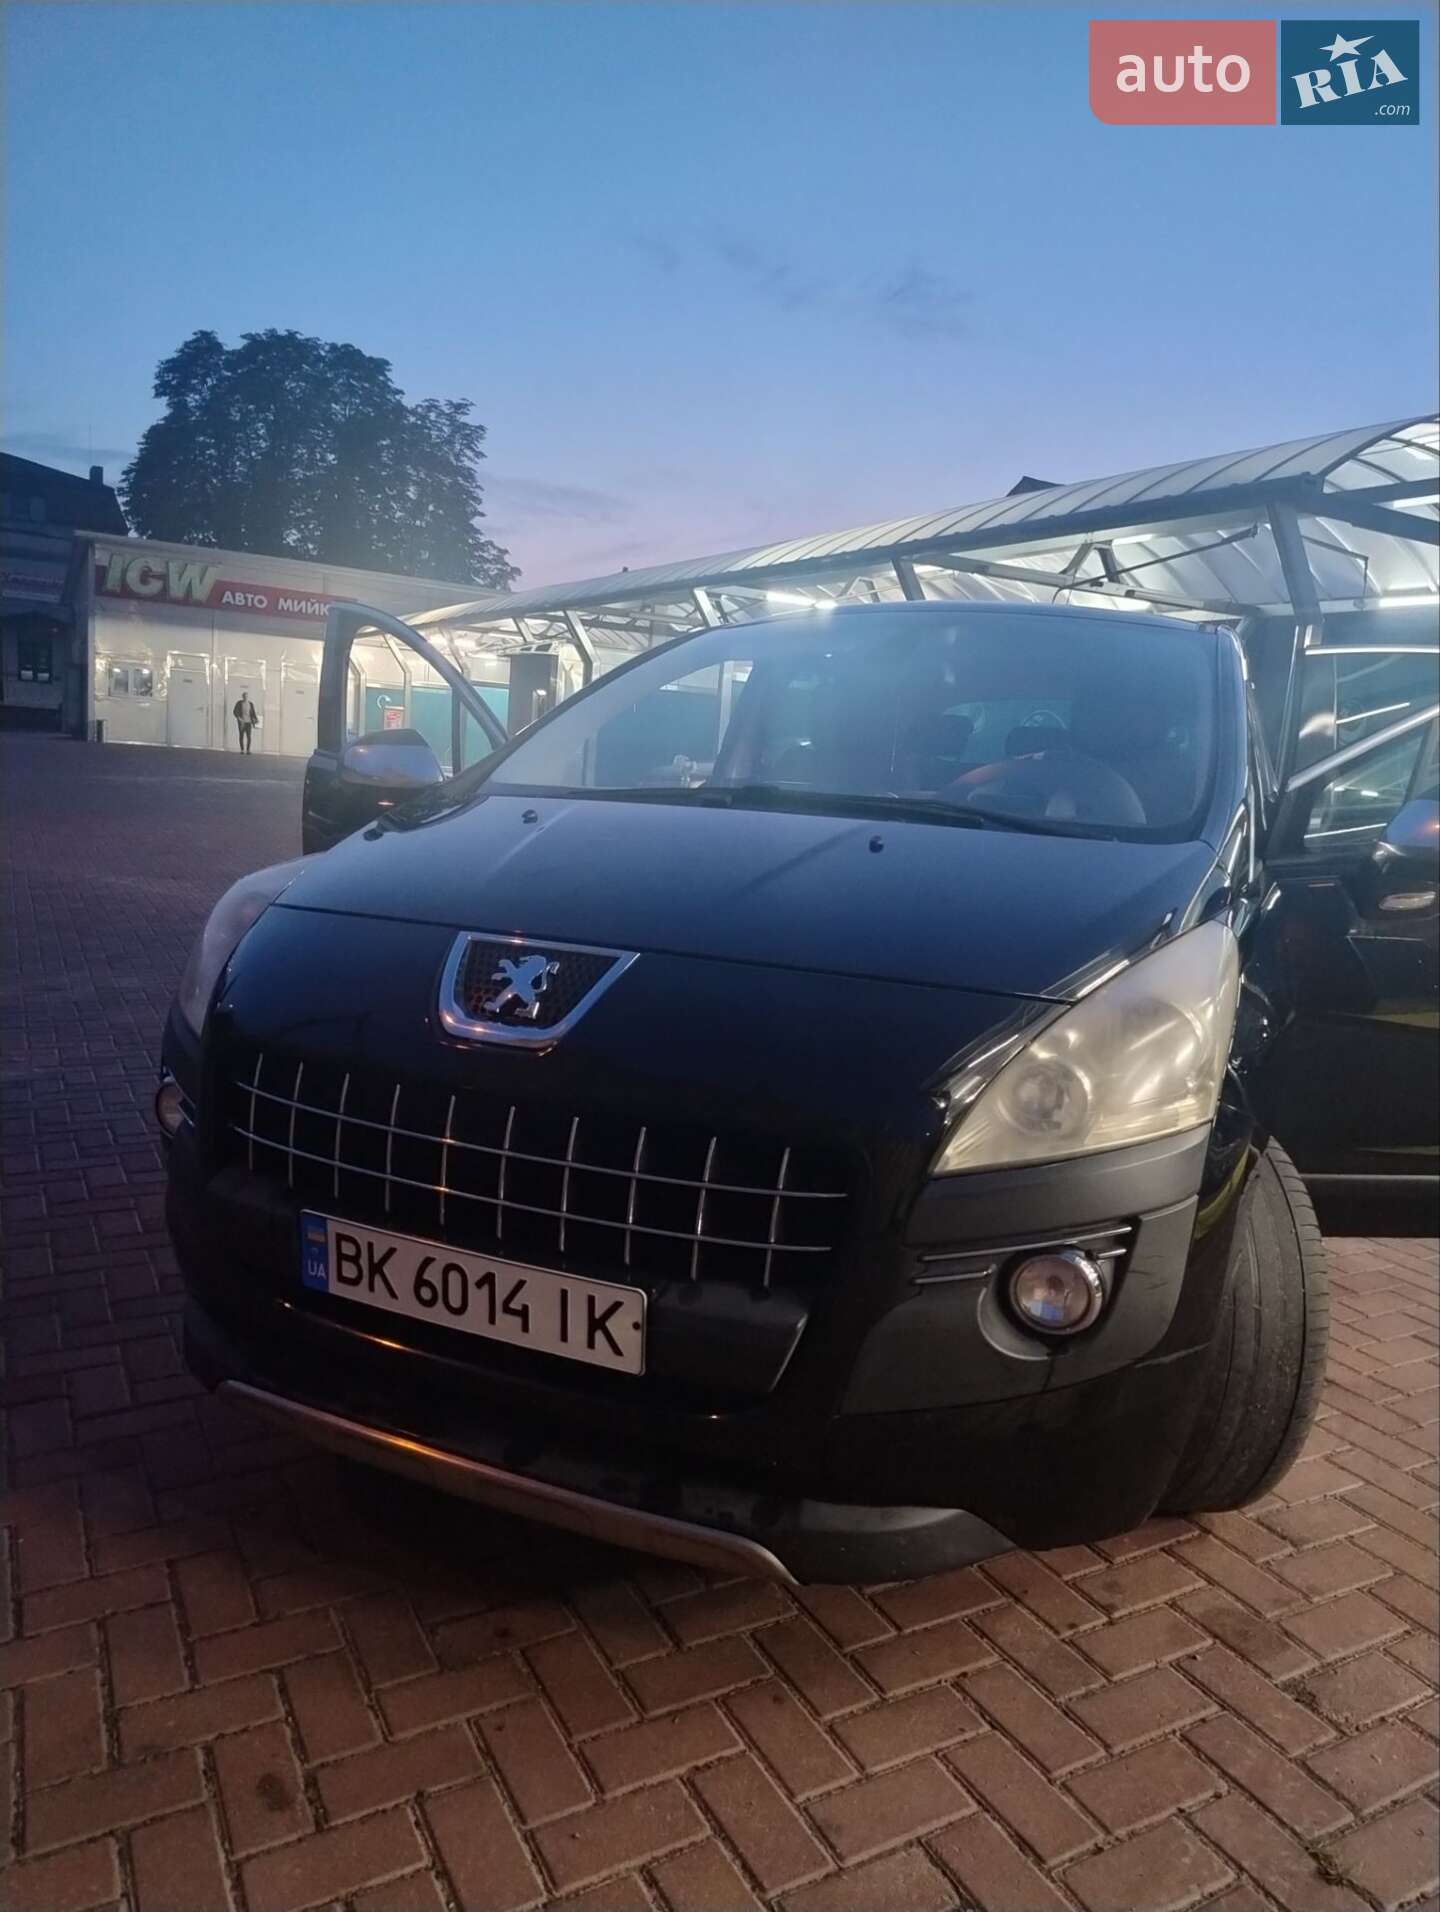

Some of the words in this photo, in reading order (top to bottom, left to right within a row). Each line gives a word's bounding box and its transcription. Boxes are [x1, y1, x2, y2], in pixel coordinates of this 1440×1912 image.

[105, 554, 222, 602] ICW
[222, 591, 268, 609] АВТО
[278, 598, 330, 616] МИЙК
[307, 1260, 327, 1280] UA
[335, 1232, 399, 1300] BK
[413, 1257, 530, 1333] 6014
[560, 1288, 624, 1357] IK
